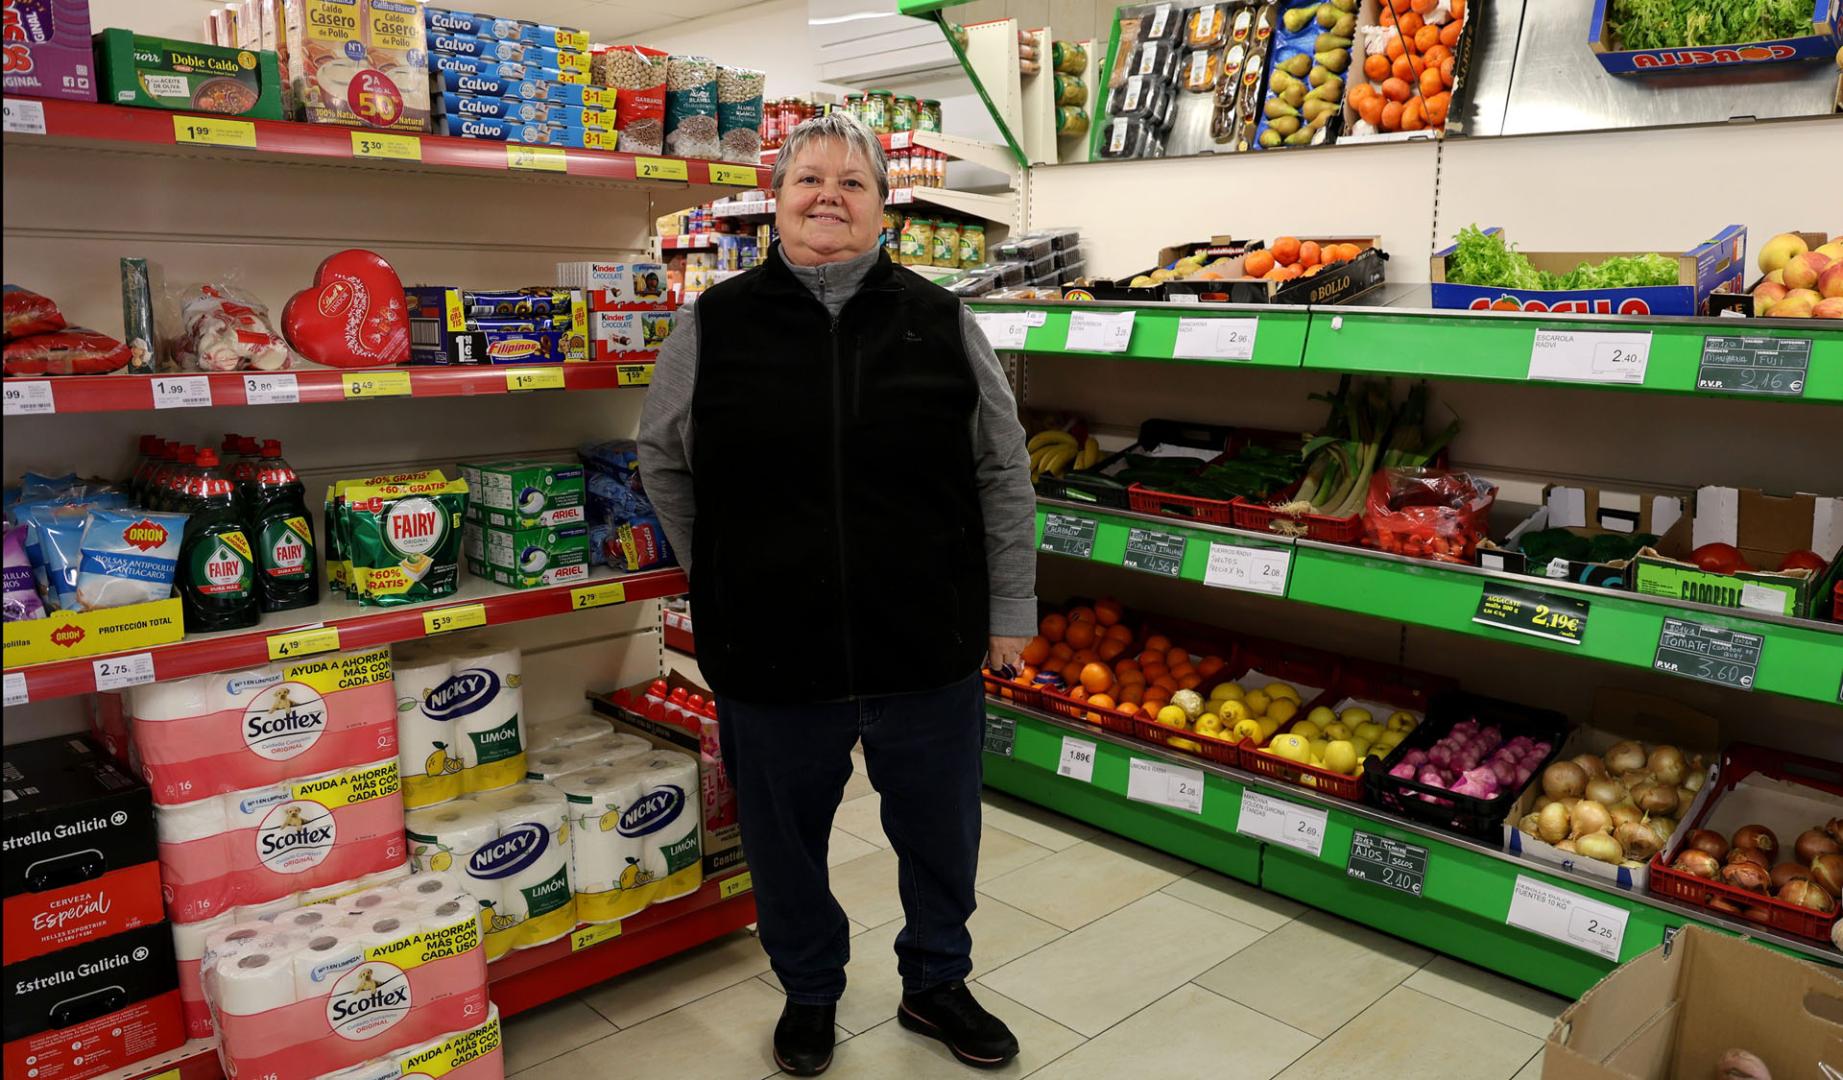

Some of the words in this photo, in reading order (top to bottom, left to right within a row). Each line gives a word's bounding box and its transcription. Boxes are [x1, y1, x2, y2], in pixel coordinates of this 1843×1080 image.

[321, 3, 343, 14] Caldo
[310, 8, 355, 28] Casero
[373, 18, 416, 36] Casero
[384, 13, 405, 23] Caldo
[431, 14, 472, 31] Calvo
[328, 28, 349, 39] Pollo
[391, 37, 411, 47] Pollo
[435, 37, 475, 53] Calvo
[133, 50, 161, 63] norr
[171, 53, 205, 68] Doble
[207, 56, 239, 72] Caldo
[437, 58, 476, 73] Calvo
[458, 76, 499, 93] Calvo
[458, 99, 499, 115] Calvo
[461, 121, 501, 137] Calvo
[1317, 277, 1350, 302] BOLLO
[487, 341, 537, 356] Filipinos
[1612, 349, 1637, 363] 2.40
[551, 508, 580, 520] ARIEL
[129, 527, 164, 542] ORION
[392, 511, 436, 540] FAIRY
[276, 544, 302, 561] FAIRY
[208, 560, 239, 578] FAIRY
[554, 566, 583, 578] ARIEL
[98, 620, 149, 635] PROTECCIÓN
[149, 616, 173, 627] TOTAL
[56, 629, 80, 641] ORION
[1664, 634, 1708, 652] TOMATE
[290, 664, 329, 677] AYUDA
[330, 661, 339, 670] A
[343, 650, 390, 669] AHORRAR
[338, 676, 369, 689] CADA
[431, 675, 480, 709] NICKY
[248, 710, 323, 738] Scottex
[480, 727, 516, 744] LIMÓN
[178, 780, 192, 791] 16
[300, 781, 338, 795] AYUDA
[339, 778, 348, 786] A
[351, 763, 398, 783] AHORRAR
[379, 773, 399, 786] CON
[347, 791, 378, 803] CADA
[380, 782, 399, 796] USO
[624, 793, 669, 828] NICKY
[54, 817, 108, 839] Galicia
[262, 826, 332, 855] Scottex
[670, 836, 697, 856] LIMÓN
[475, 832, 531, 869] NICKY
[532, 877, 566, 898] LIMÓN
[50, 893, 92, 909] CERVEZA
[32, 891, 111, 931] Especial
[372, 940, 412, 958] AYUDA
[413, 935, 422, 944] A
[424, 918, 476, 942] AHORRAR
[454, 928, 477, 944] CON
[1587, 919, 1613, 940] 2.25
[421, 949, 454, 962] CADA
[456, 938, 477, 955] USO
[15, 969, 75, 996] Estrella
[77, 953, 130, 977] Galicia
[333, 985, 408, 1021] Scottex
[407, 1048, 443, 1070] AYUDA
[444, 1043, 451, 1052] A
[453, 1019, 498, 1049] AHORRAR
[479, 1029, 499, 1045] CON
[451, 1052, 478, 1068] CADA
[480, 1038, 499, 1054] USO
